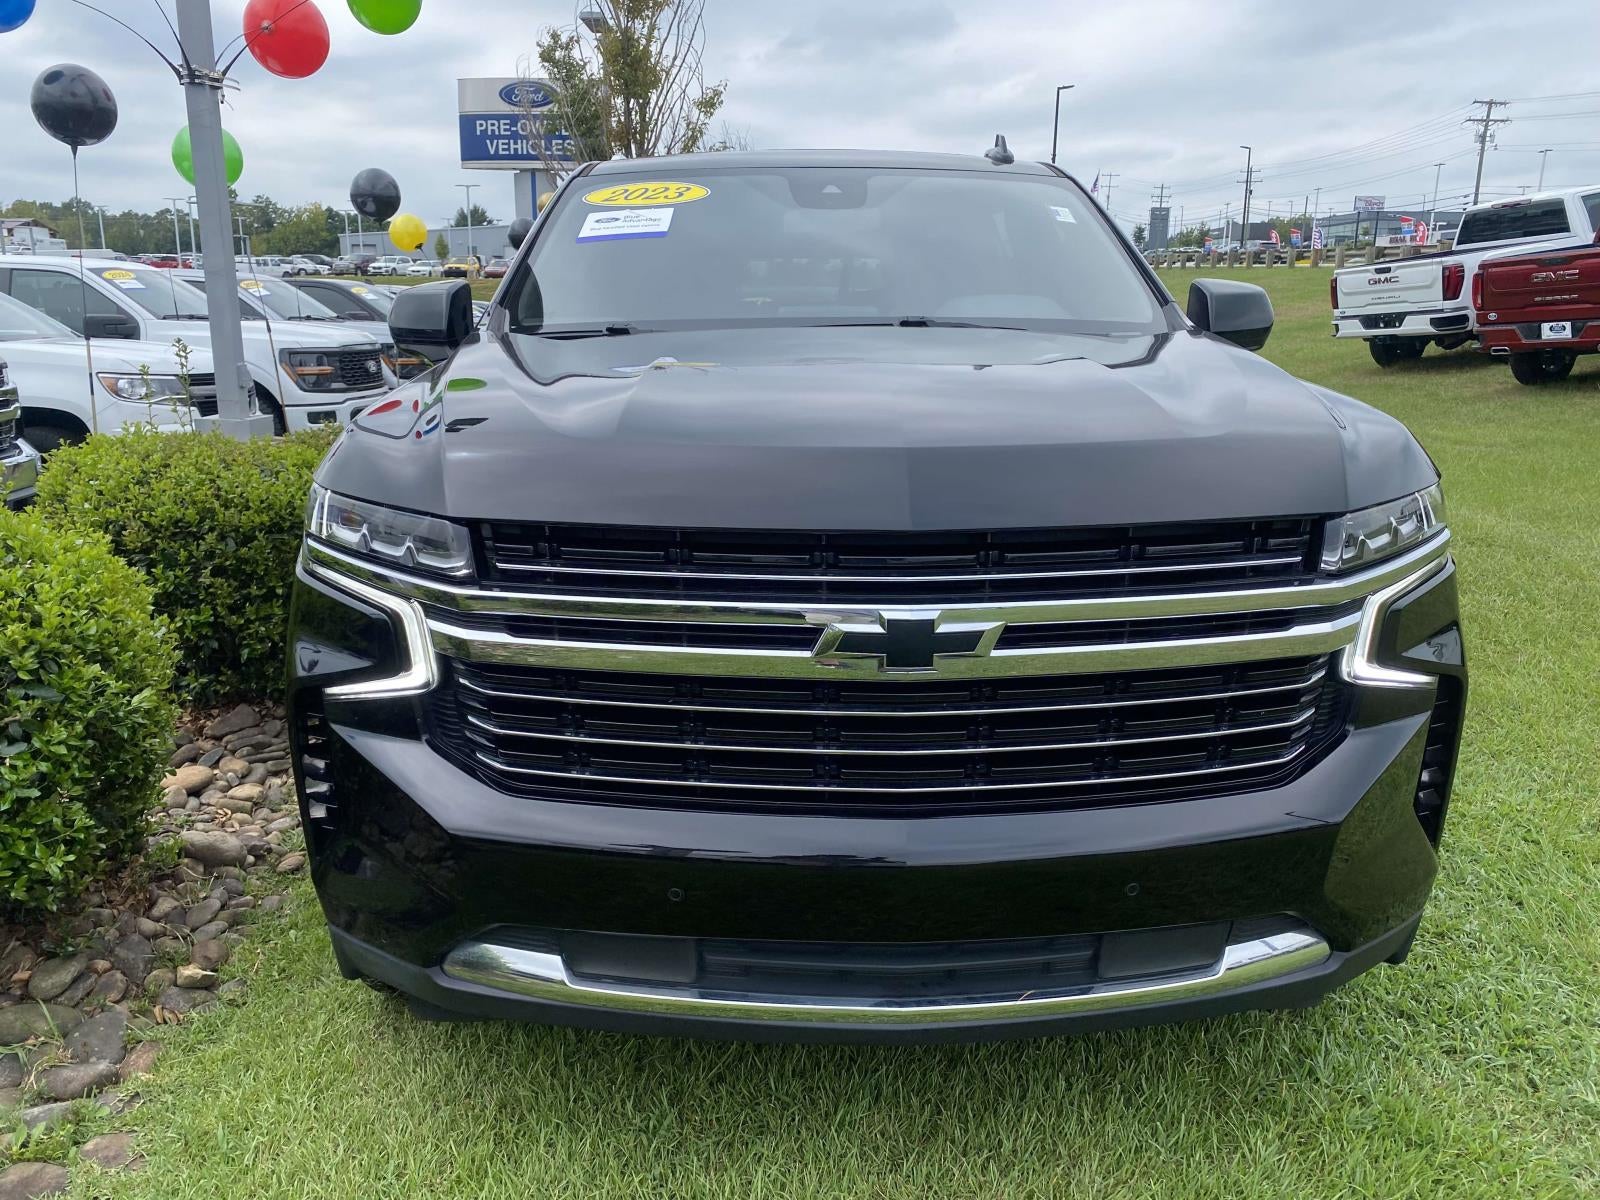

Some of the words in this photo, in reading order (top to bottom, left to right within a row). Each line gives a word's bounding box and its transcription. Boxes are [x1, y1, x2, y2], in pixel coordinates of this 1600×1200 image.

[511, 87, 545, 102] Ford
[475, 119, 571, 136] PRE-OWE
[486, 139, 575, 155] VEHICLES
[600, 186, 692, 202] 2023
[1368, 276, 1400, 286] GMC
[1531, 269, 1580, 283] GMC
